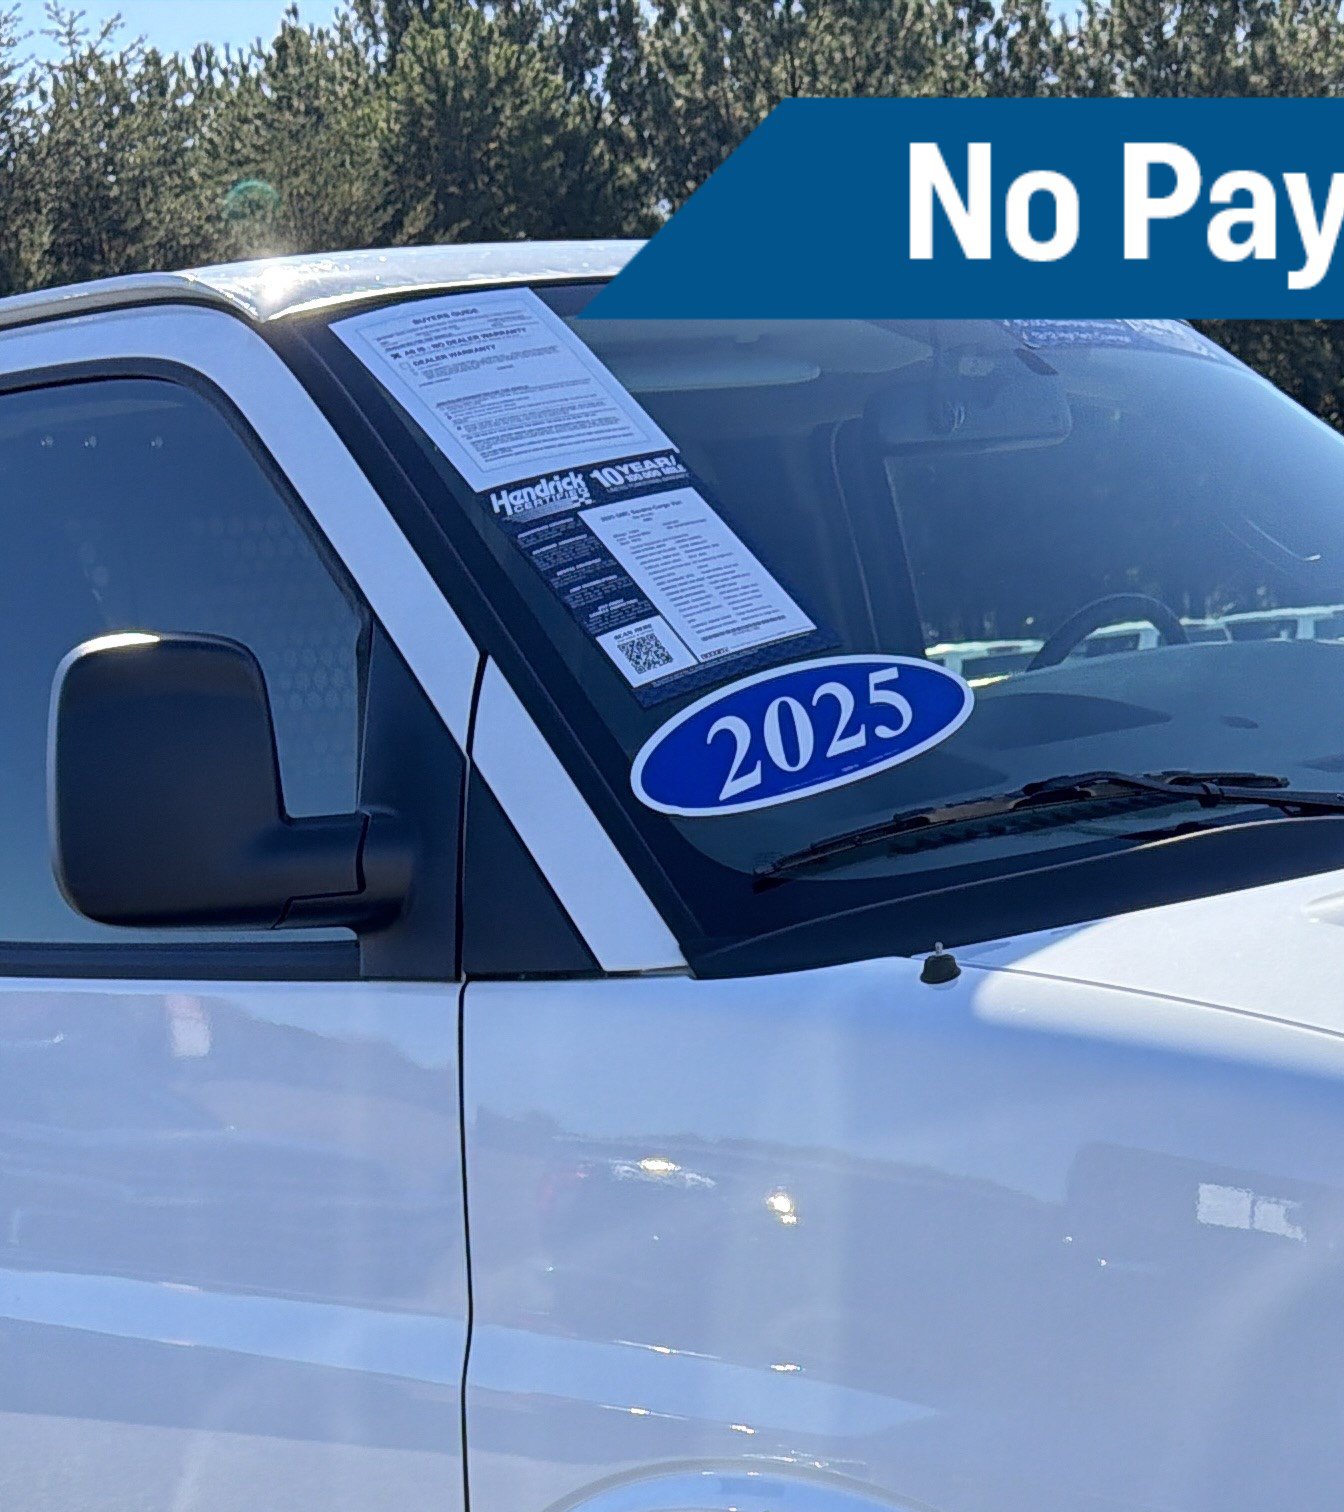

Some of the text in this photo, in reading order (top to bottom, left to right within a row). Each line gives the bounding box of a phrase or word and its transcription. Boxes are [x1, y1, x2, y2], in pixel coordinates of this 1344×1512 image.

[490, 471, 587, 515] Hendrick
[590, 469, 625, 489] 10
[706, 666, 913, 801] 2025
